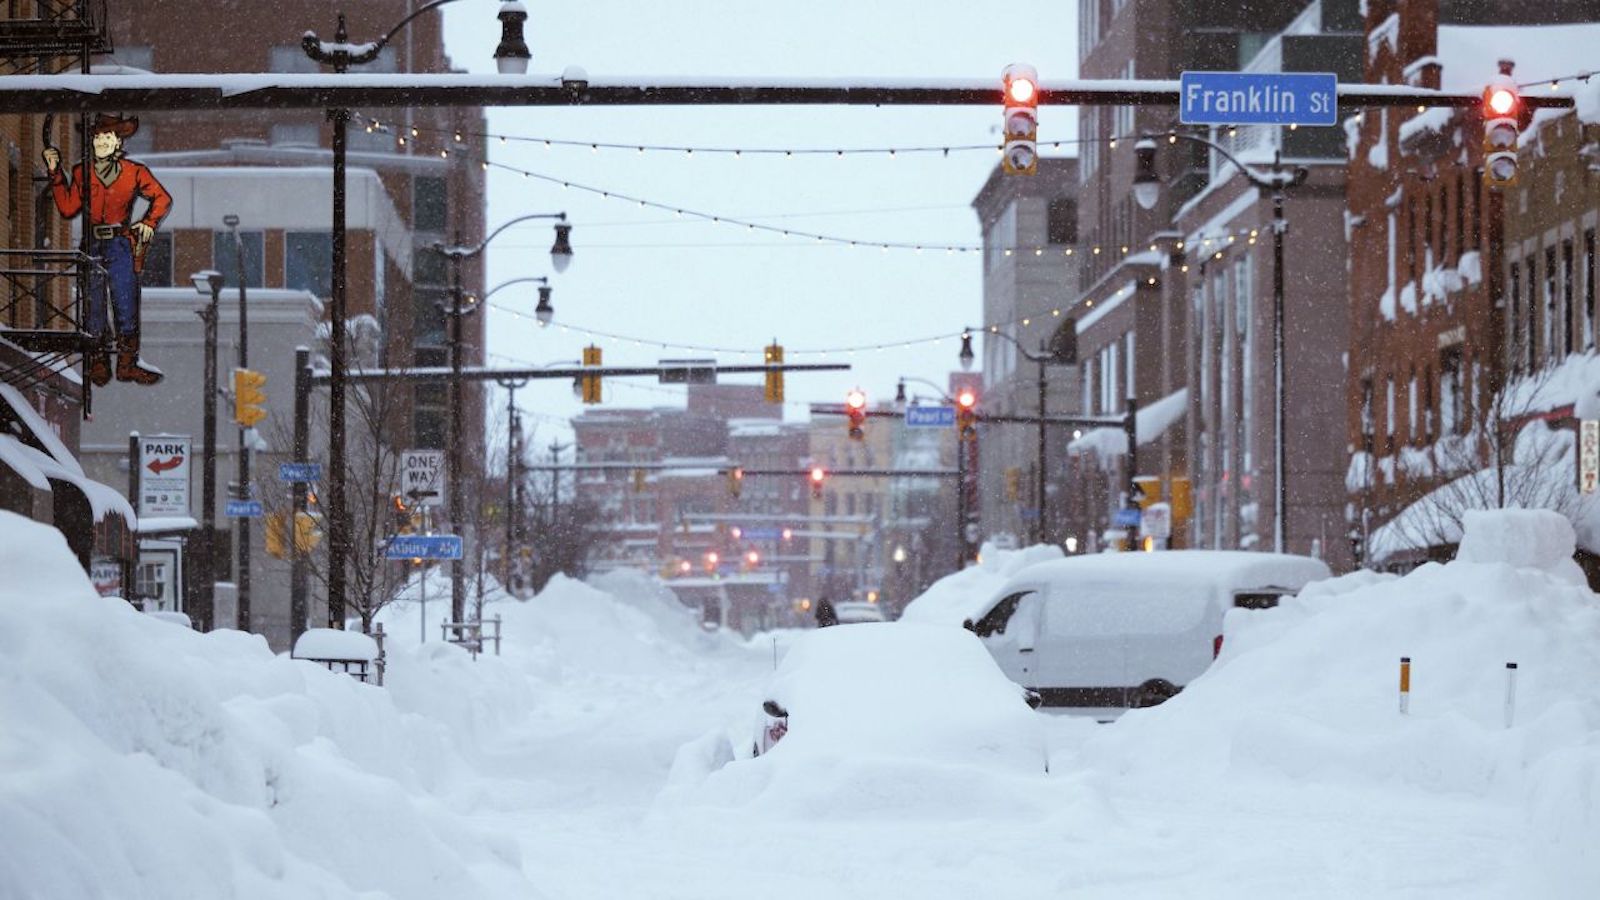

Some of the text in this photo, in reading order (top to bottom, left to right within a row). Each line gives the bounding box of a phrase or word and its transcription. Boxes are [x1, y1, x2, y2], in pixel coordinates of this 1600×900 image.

[1186, 83, 1330, 114] Franklin St
[909, 410, 940, 423] Pearl
[145, 444, 185, 455] PARK
[407, 456, 436, 469] ONE
[409, 471, 437, 483] WAY
